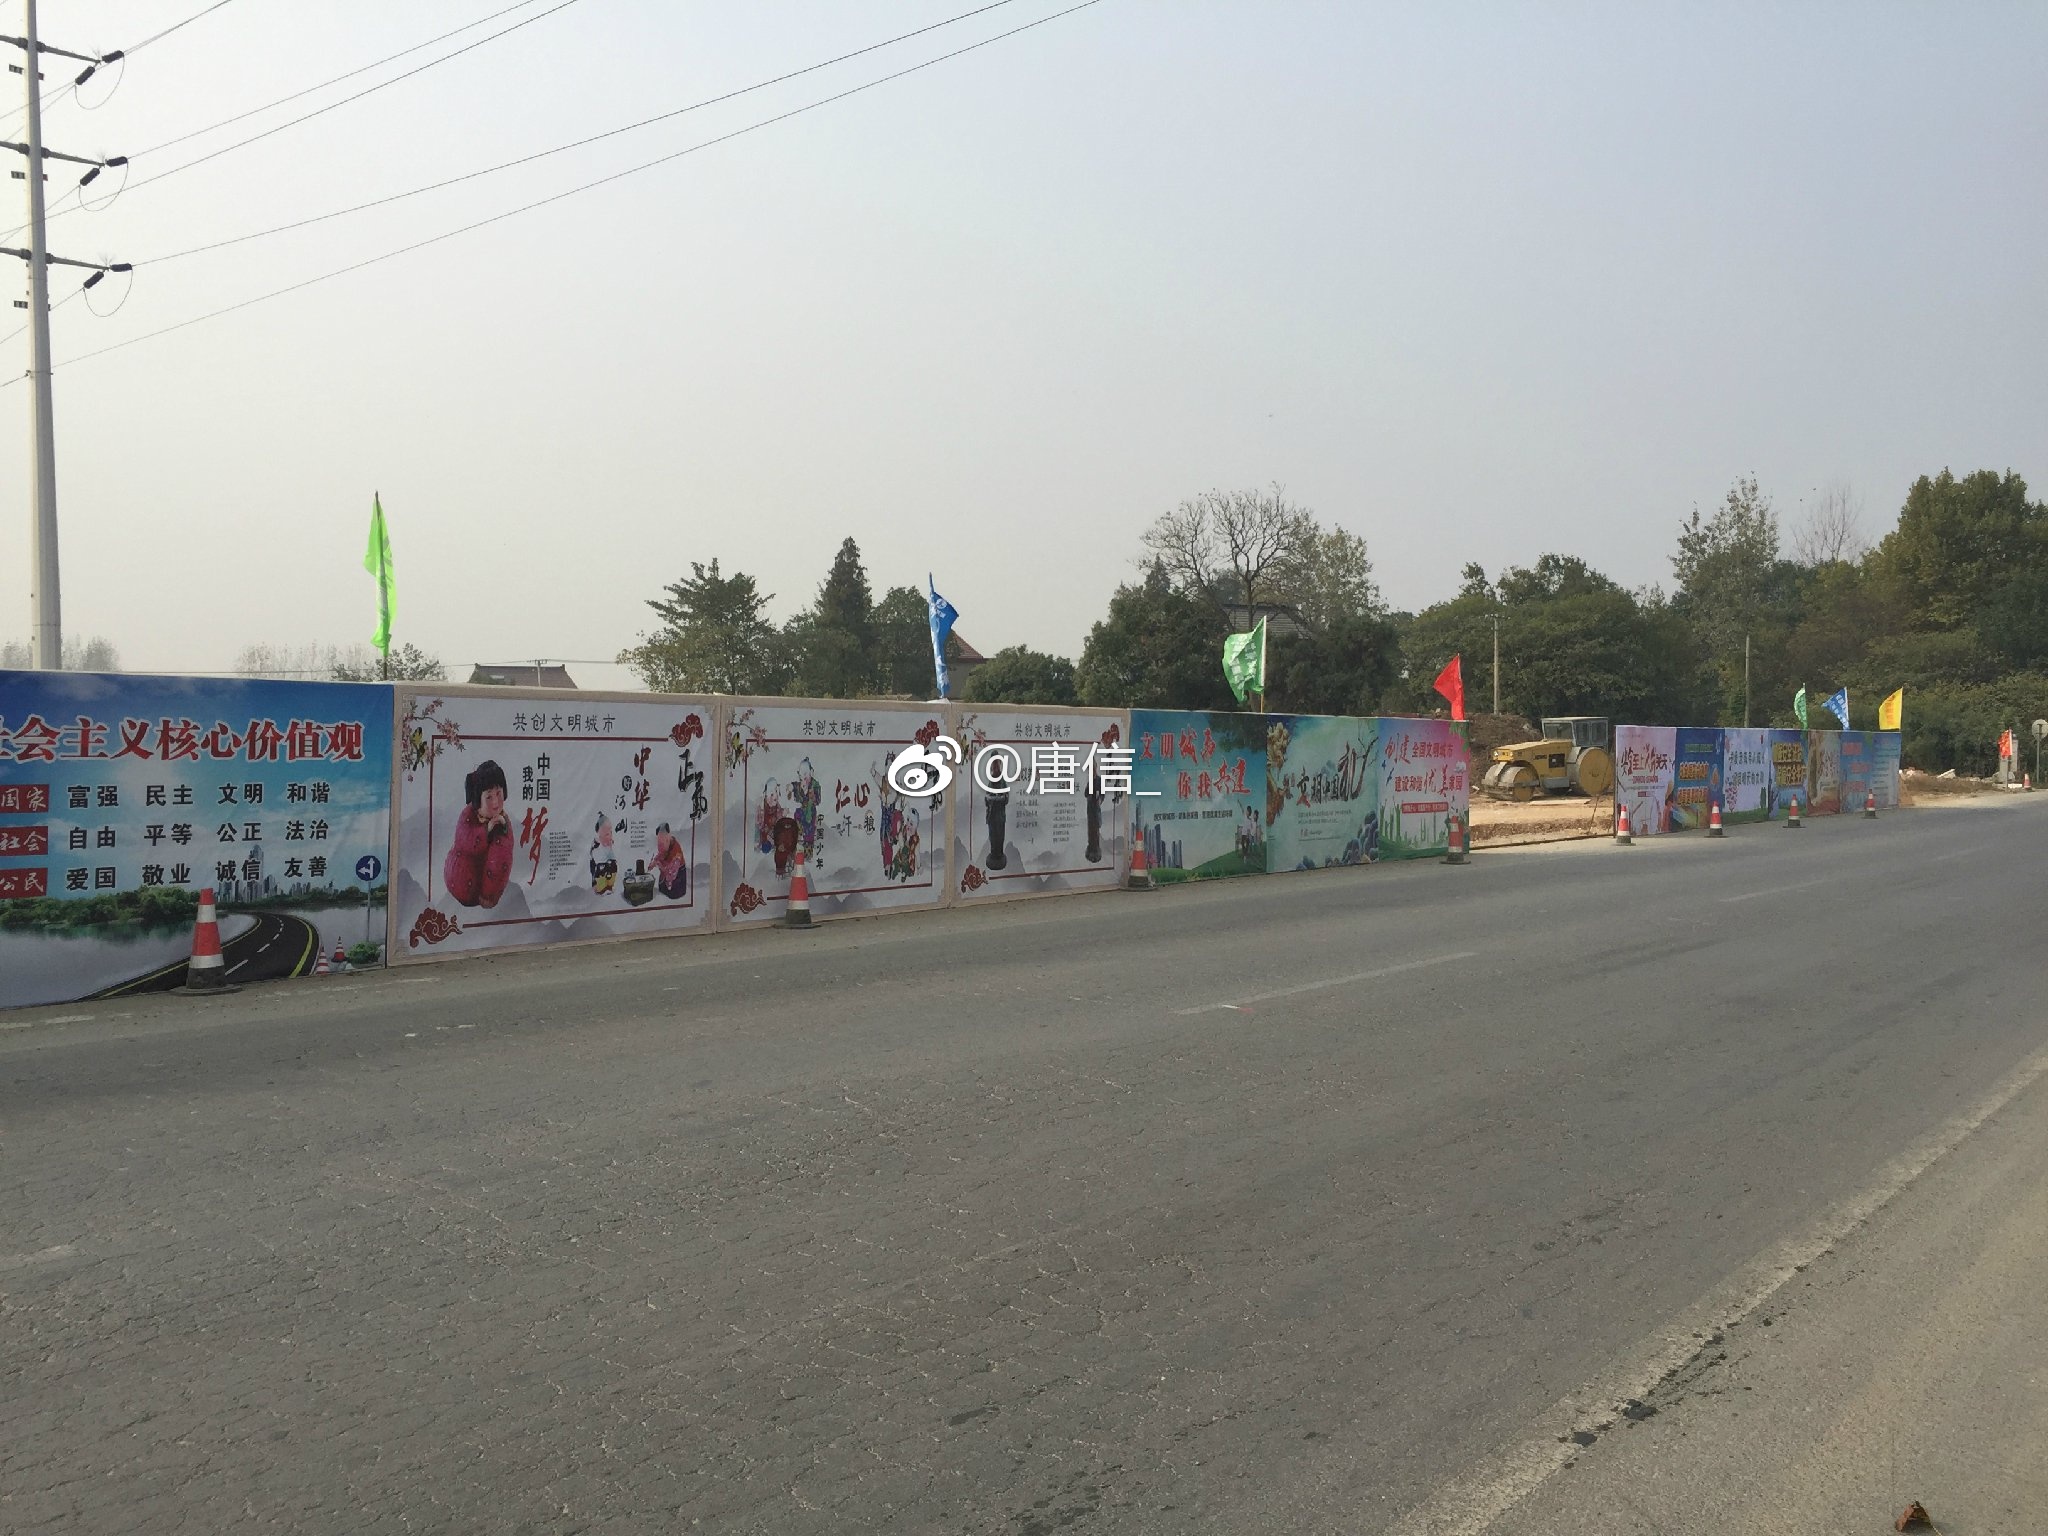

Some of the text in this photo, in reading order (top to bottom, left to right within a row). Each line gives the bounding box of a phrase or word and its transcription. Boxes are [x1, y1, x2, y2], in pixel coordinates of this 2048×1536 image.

[512, 713, 616, 733] 共创文明城市
[803, 720, 876, 736] 共创文明城市
[522, 765, 533, 801] 我的
[536, 752, 550, 801] 中国
[1, 786, 46, 812] 国家
[67, 782, 330, 808] 富强 民主 文明 和谐
[0, 830, 47, 851] 社会
[69, 819, 329, 850] 自由 平等 公正 法治
[0, 872, 44, 892] 公民
[66, 856, 328, 890] 爱国 敬业 诚信 友善
